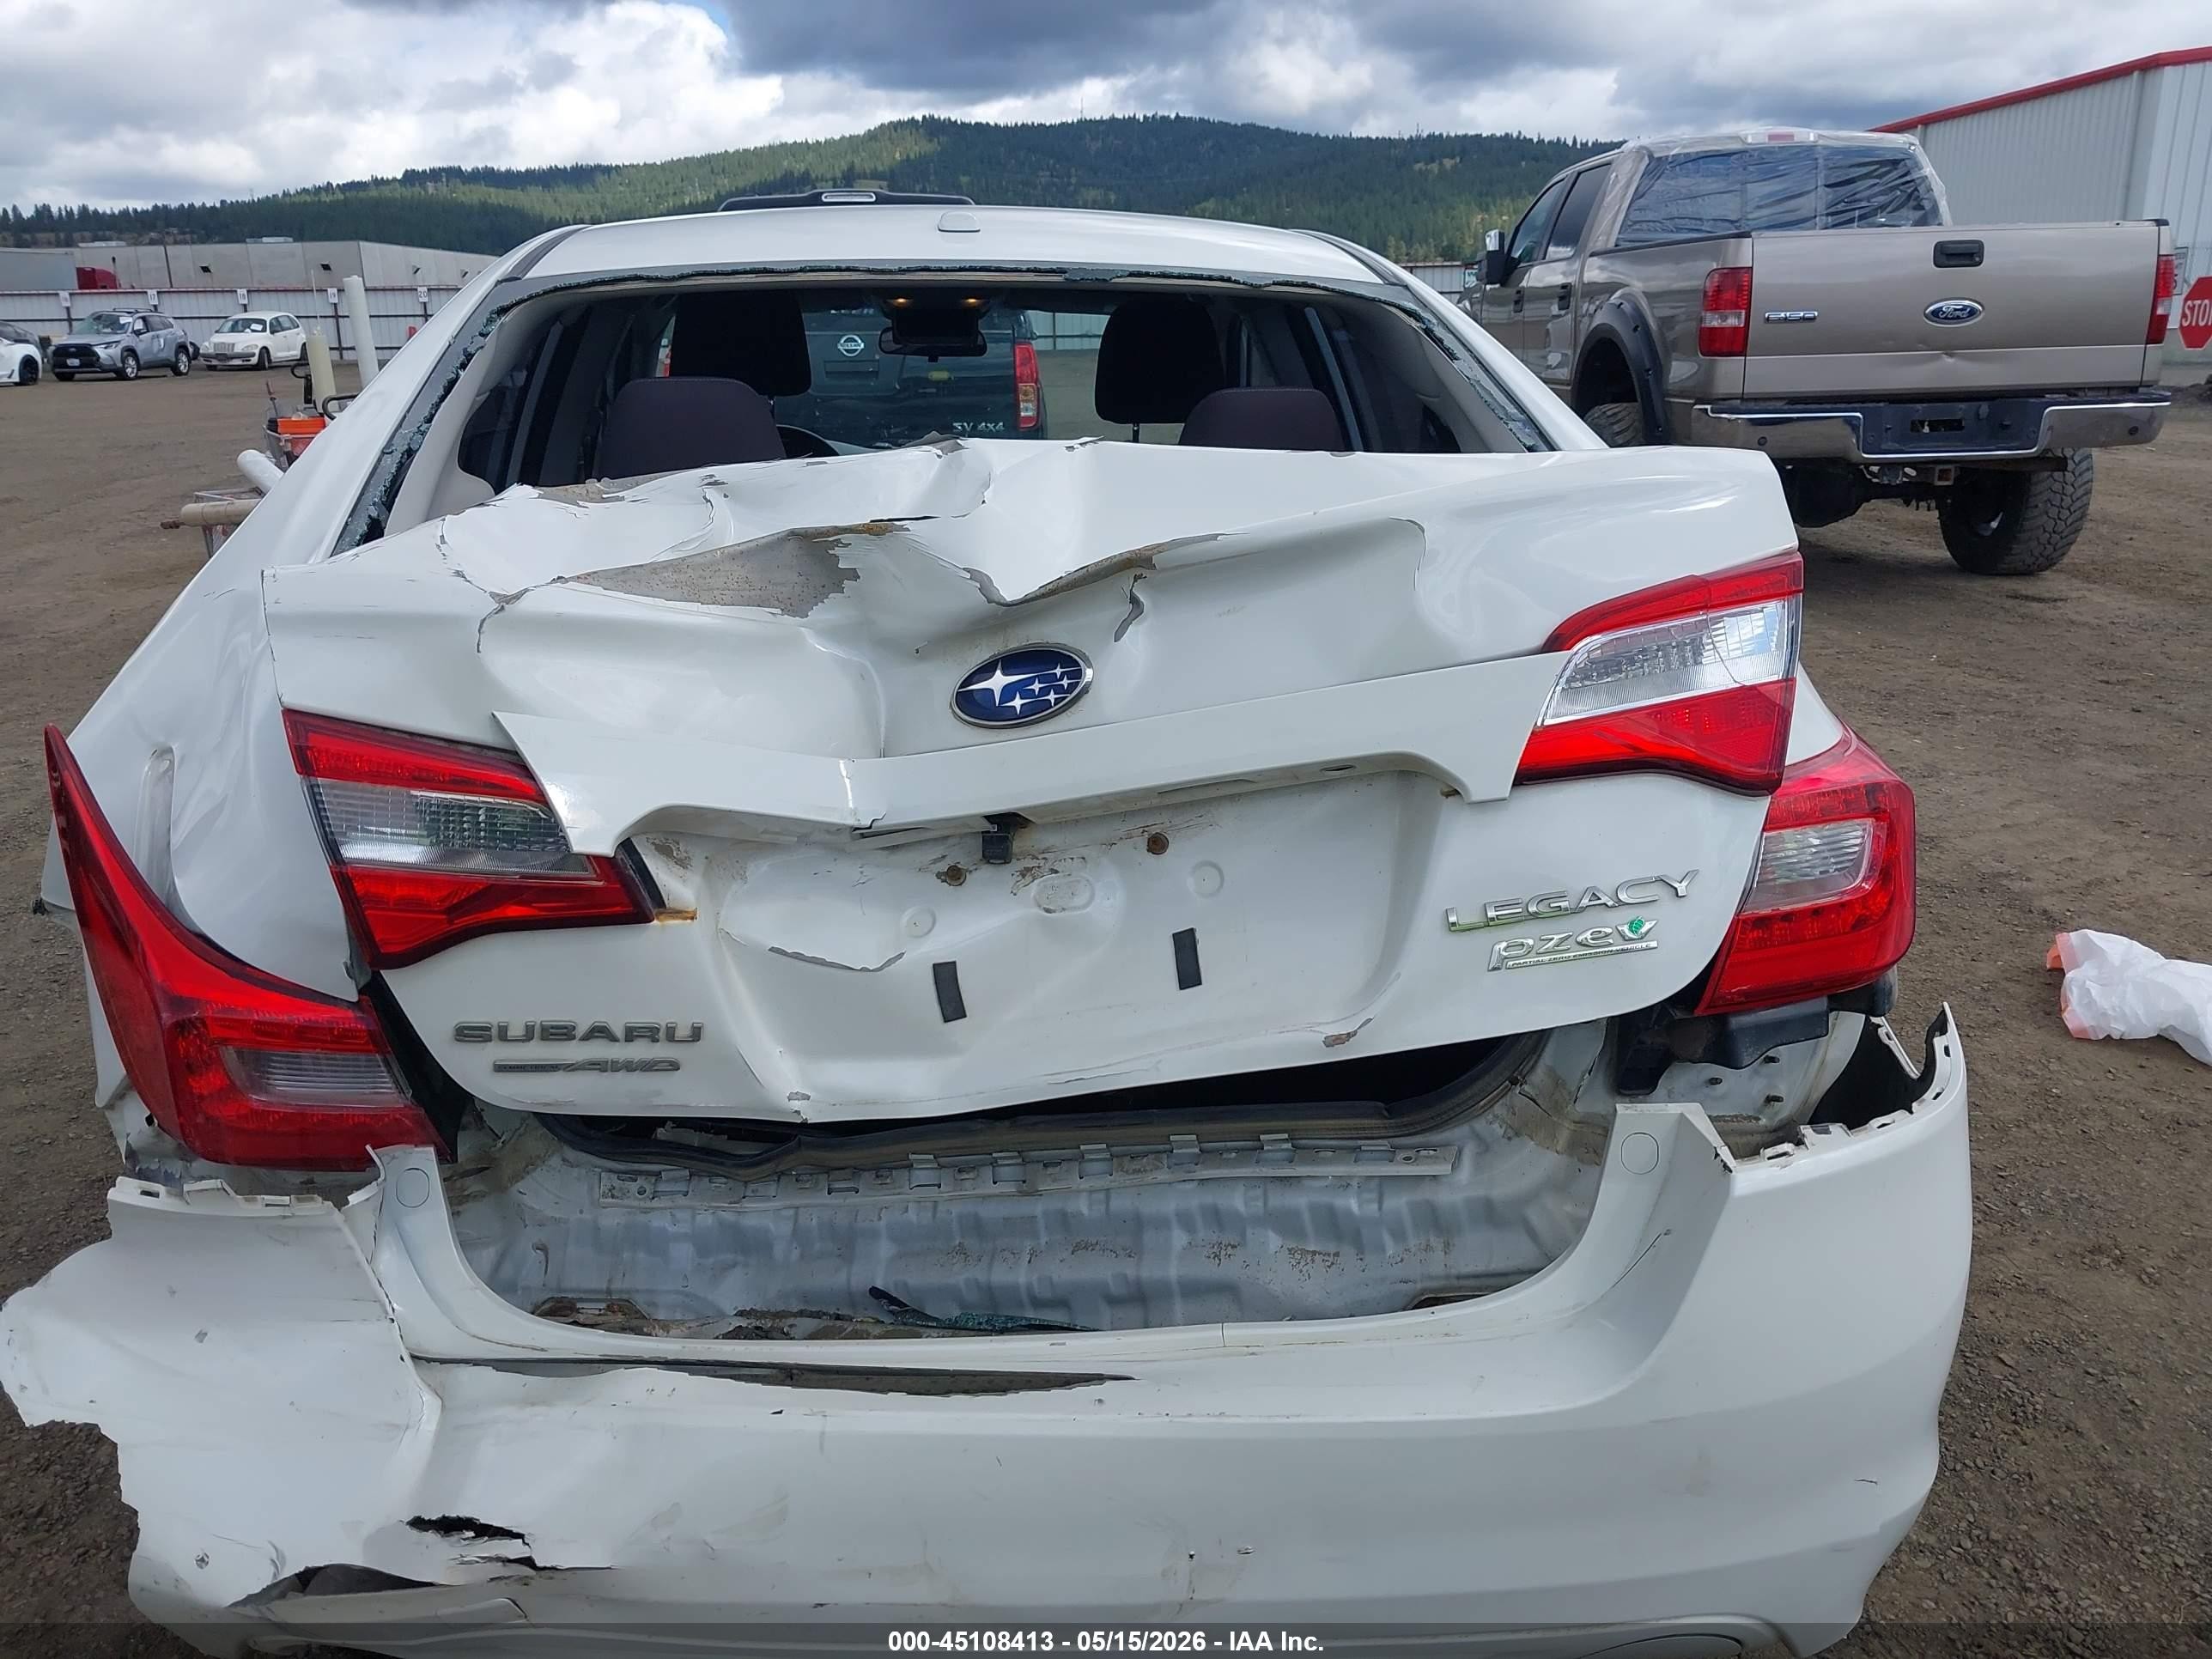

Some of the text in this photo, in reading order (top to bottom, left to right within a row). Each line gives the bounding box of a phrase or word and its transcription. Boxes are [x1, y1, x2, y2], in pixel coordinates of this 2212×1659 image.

[1938, 305, 1971, 319] Ford
[2182, 299, 2212, 326] STO
[953, 422, 973, 432] SV
[1445, 869, 1699, 932] LEGACY
[1511, 959, 1545, 968] PARTIAL
[1547, 954, 1571, 963] ZERO
[1572, 949, 1613, 959] EMISSION
[453, 1020, 704, 1043] SUBARU
[563, 1057, 681, 1073] AWD
